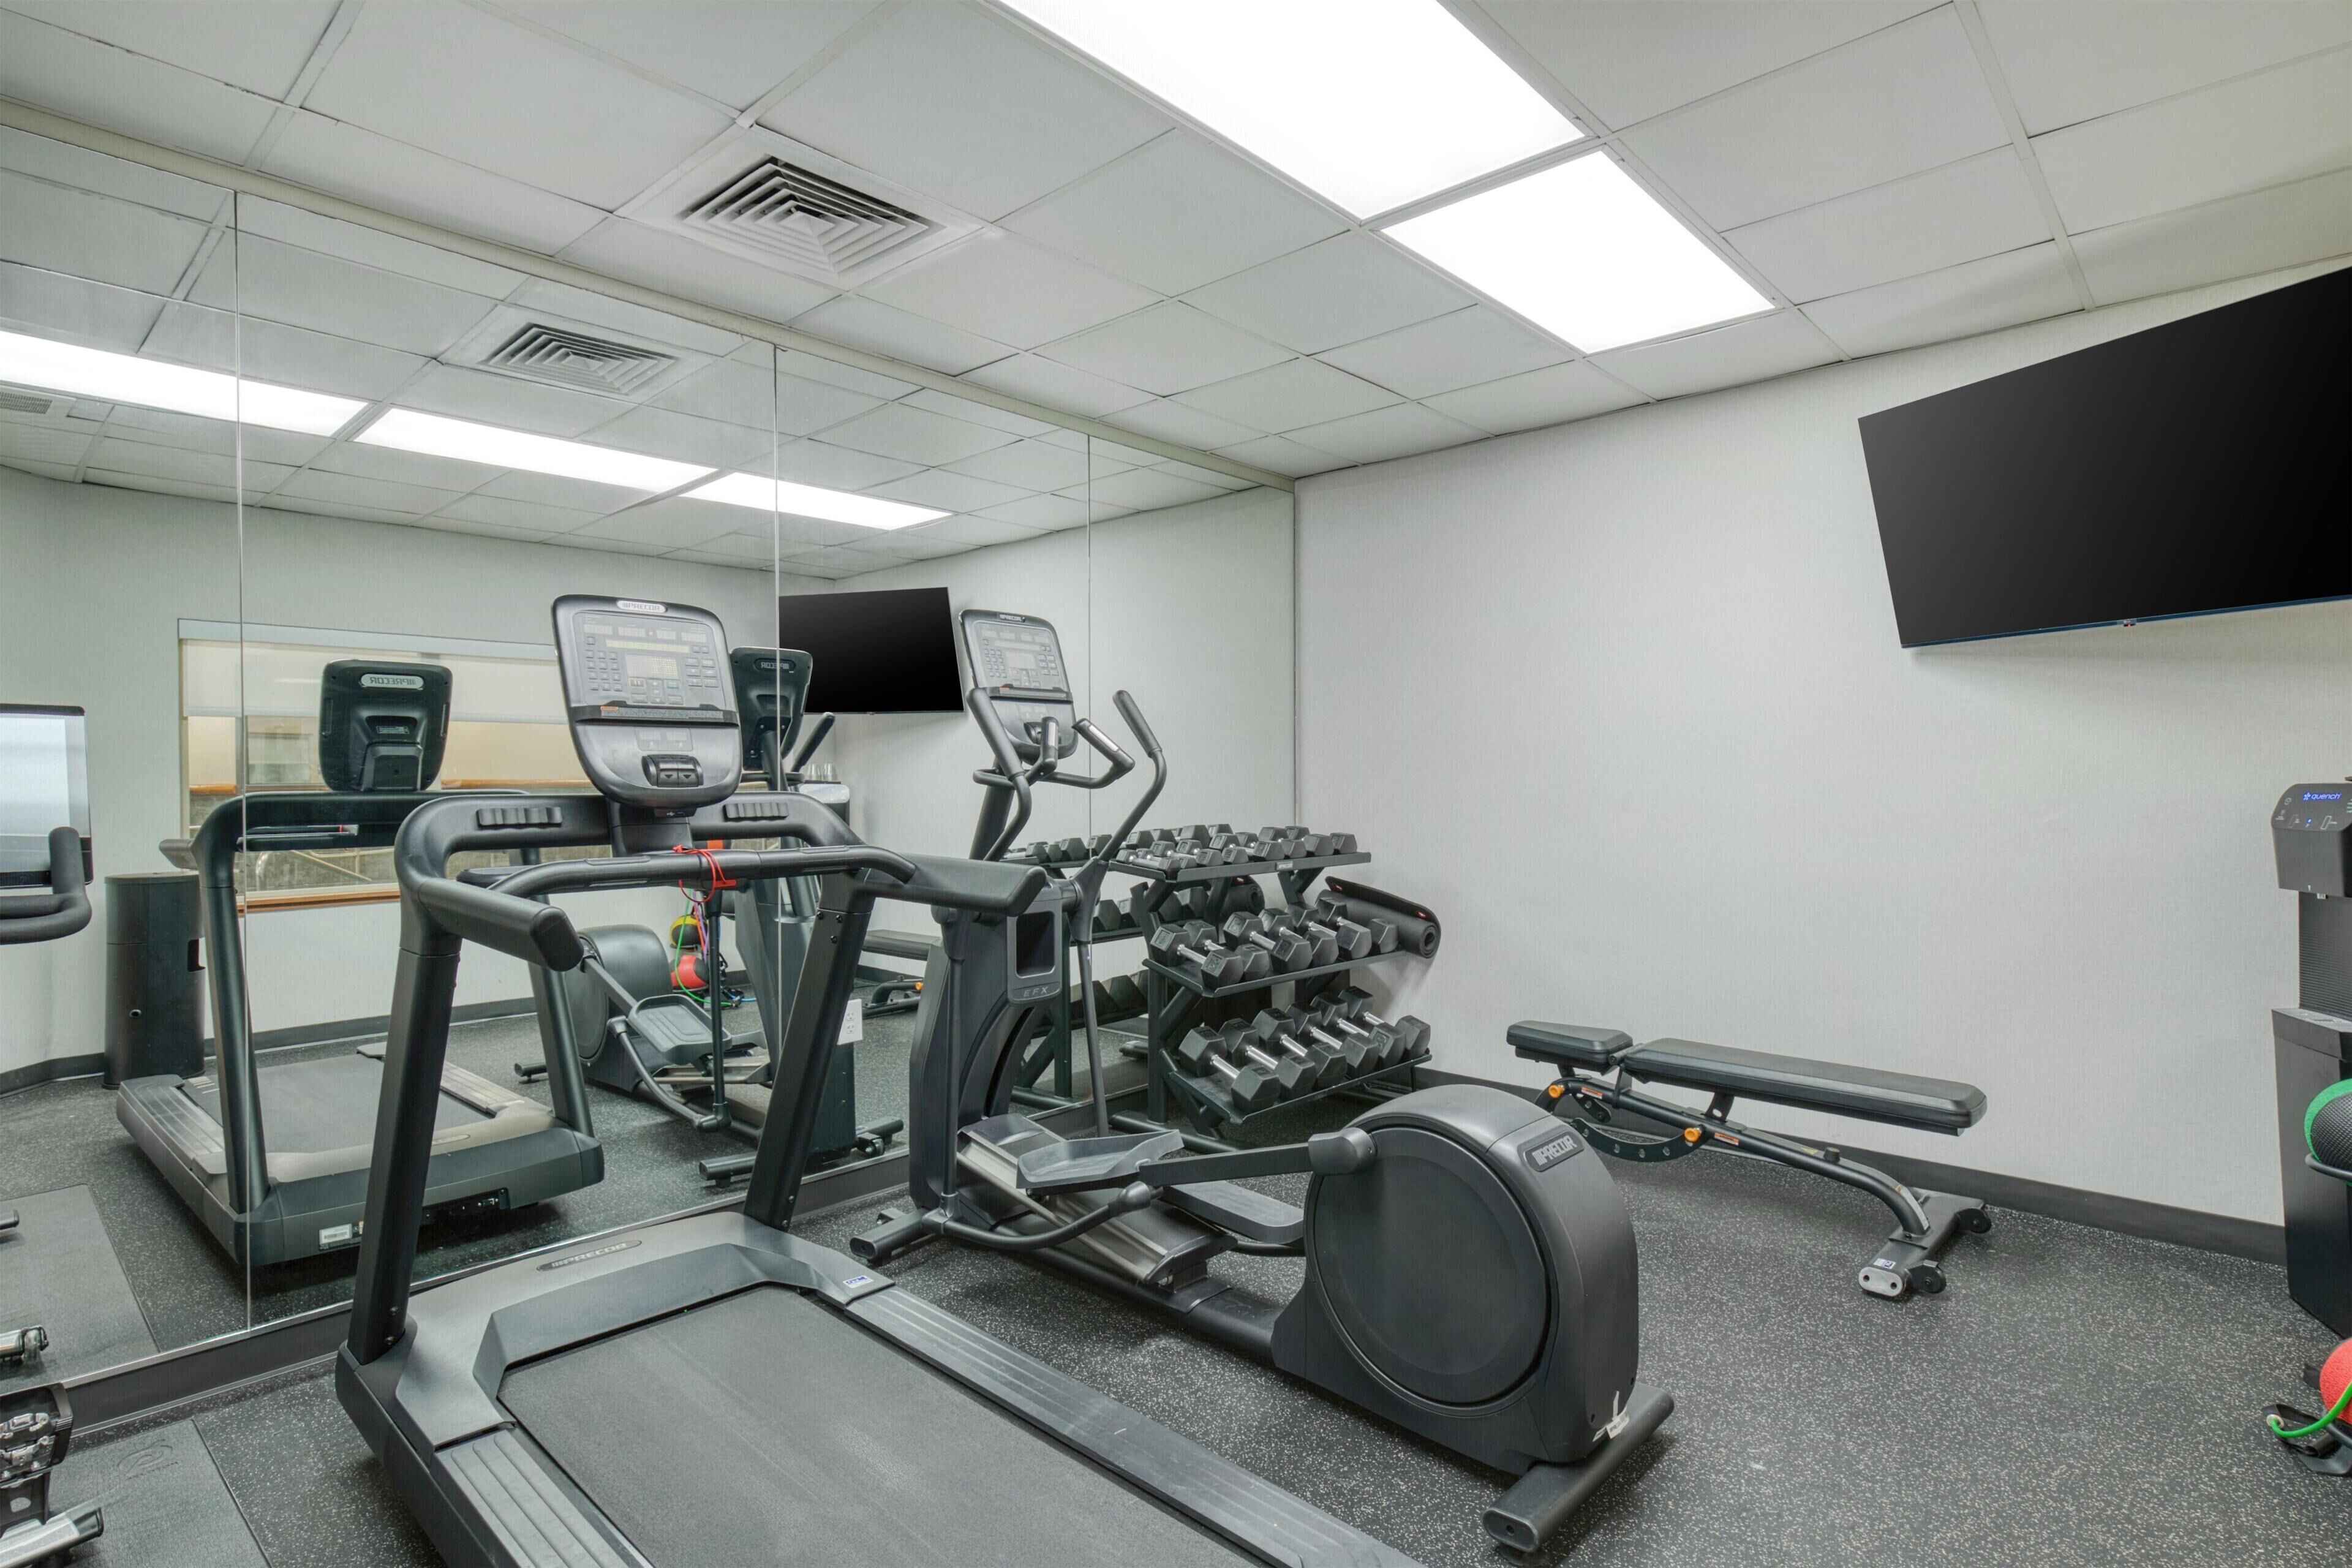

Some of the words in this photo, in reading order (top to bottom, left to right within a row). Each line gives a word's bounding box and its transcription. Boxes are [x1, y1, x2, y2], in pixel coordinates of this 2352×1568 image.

[628, 602, 660, 611] PRECOR
[1023, 986, 1049, 997] EFX
[1539, 1135, 1577, 1164] PRECOR
[563, 1243, 628, 1264] PRECOR
